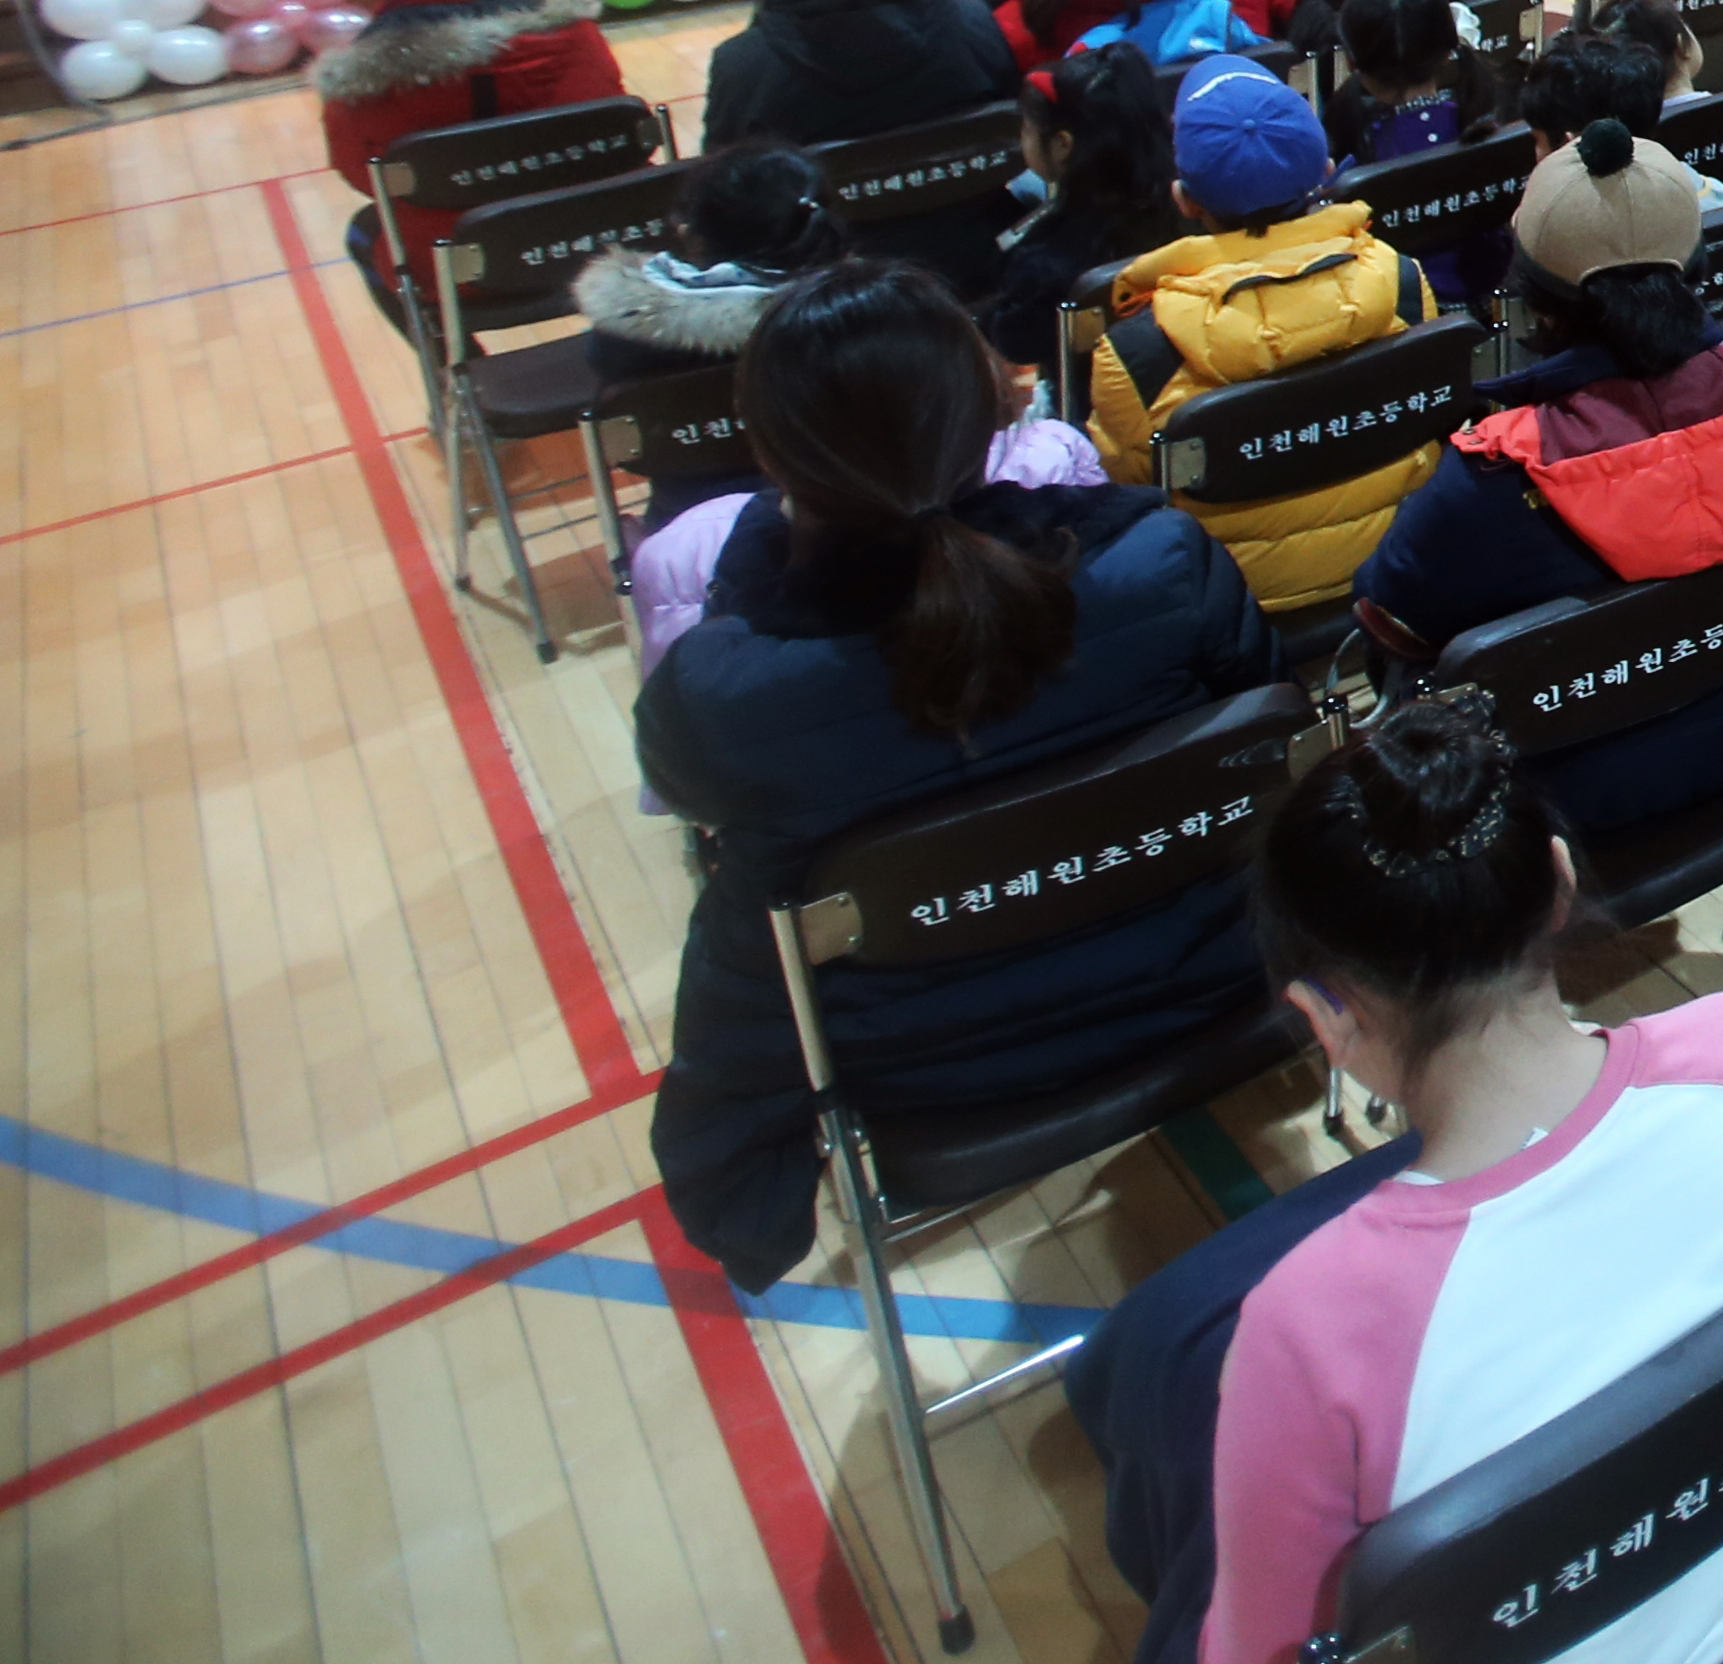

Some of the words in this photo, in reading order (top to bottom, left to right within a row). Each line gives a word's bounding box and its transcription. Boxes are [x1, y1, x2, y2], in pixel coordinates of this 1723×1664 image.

[839, 149, 1007, 200] 인천해원초등학교
[522, 218, 662, 264] 인천해원초등
[1239, 384, 1452, 460] 인천해원초등학교
[911, 795, 1254, 926] 인천해원초등학교
